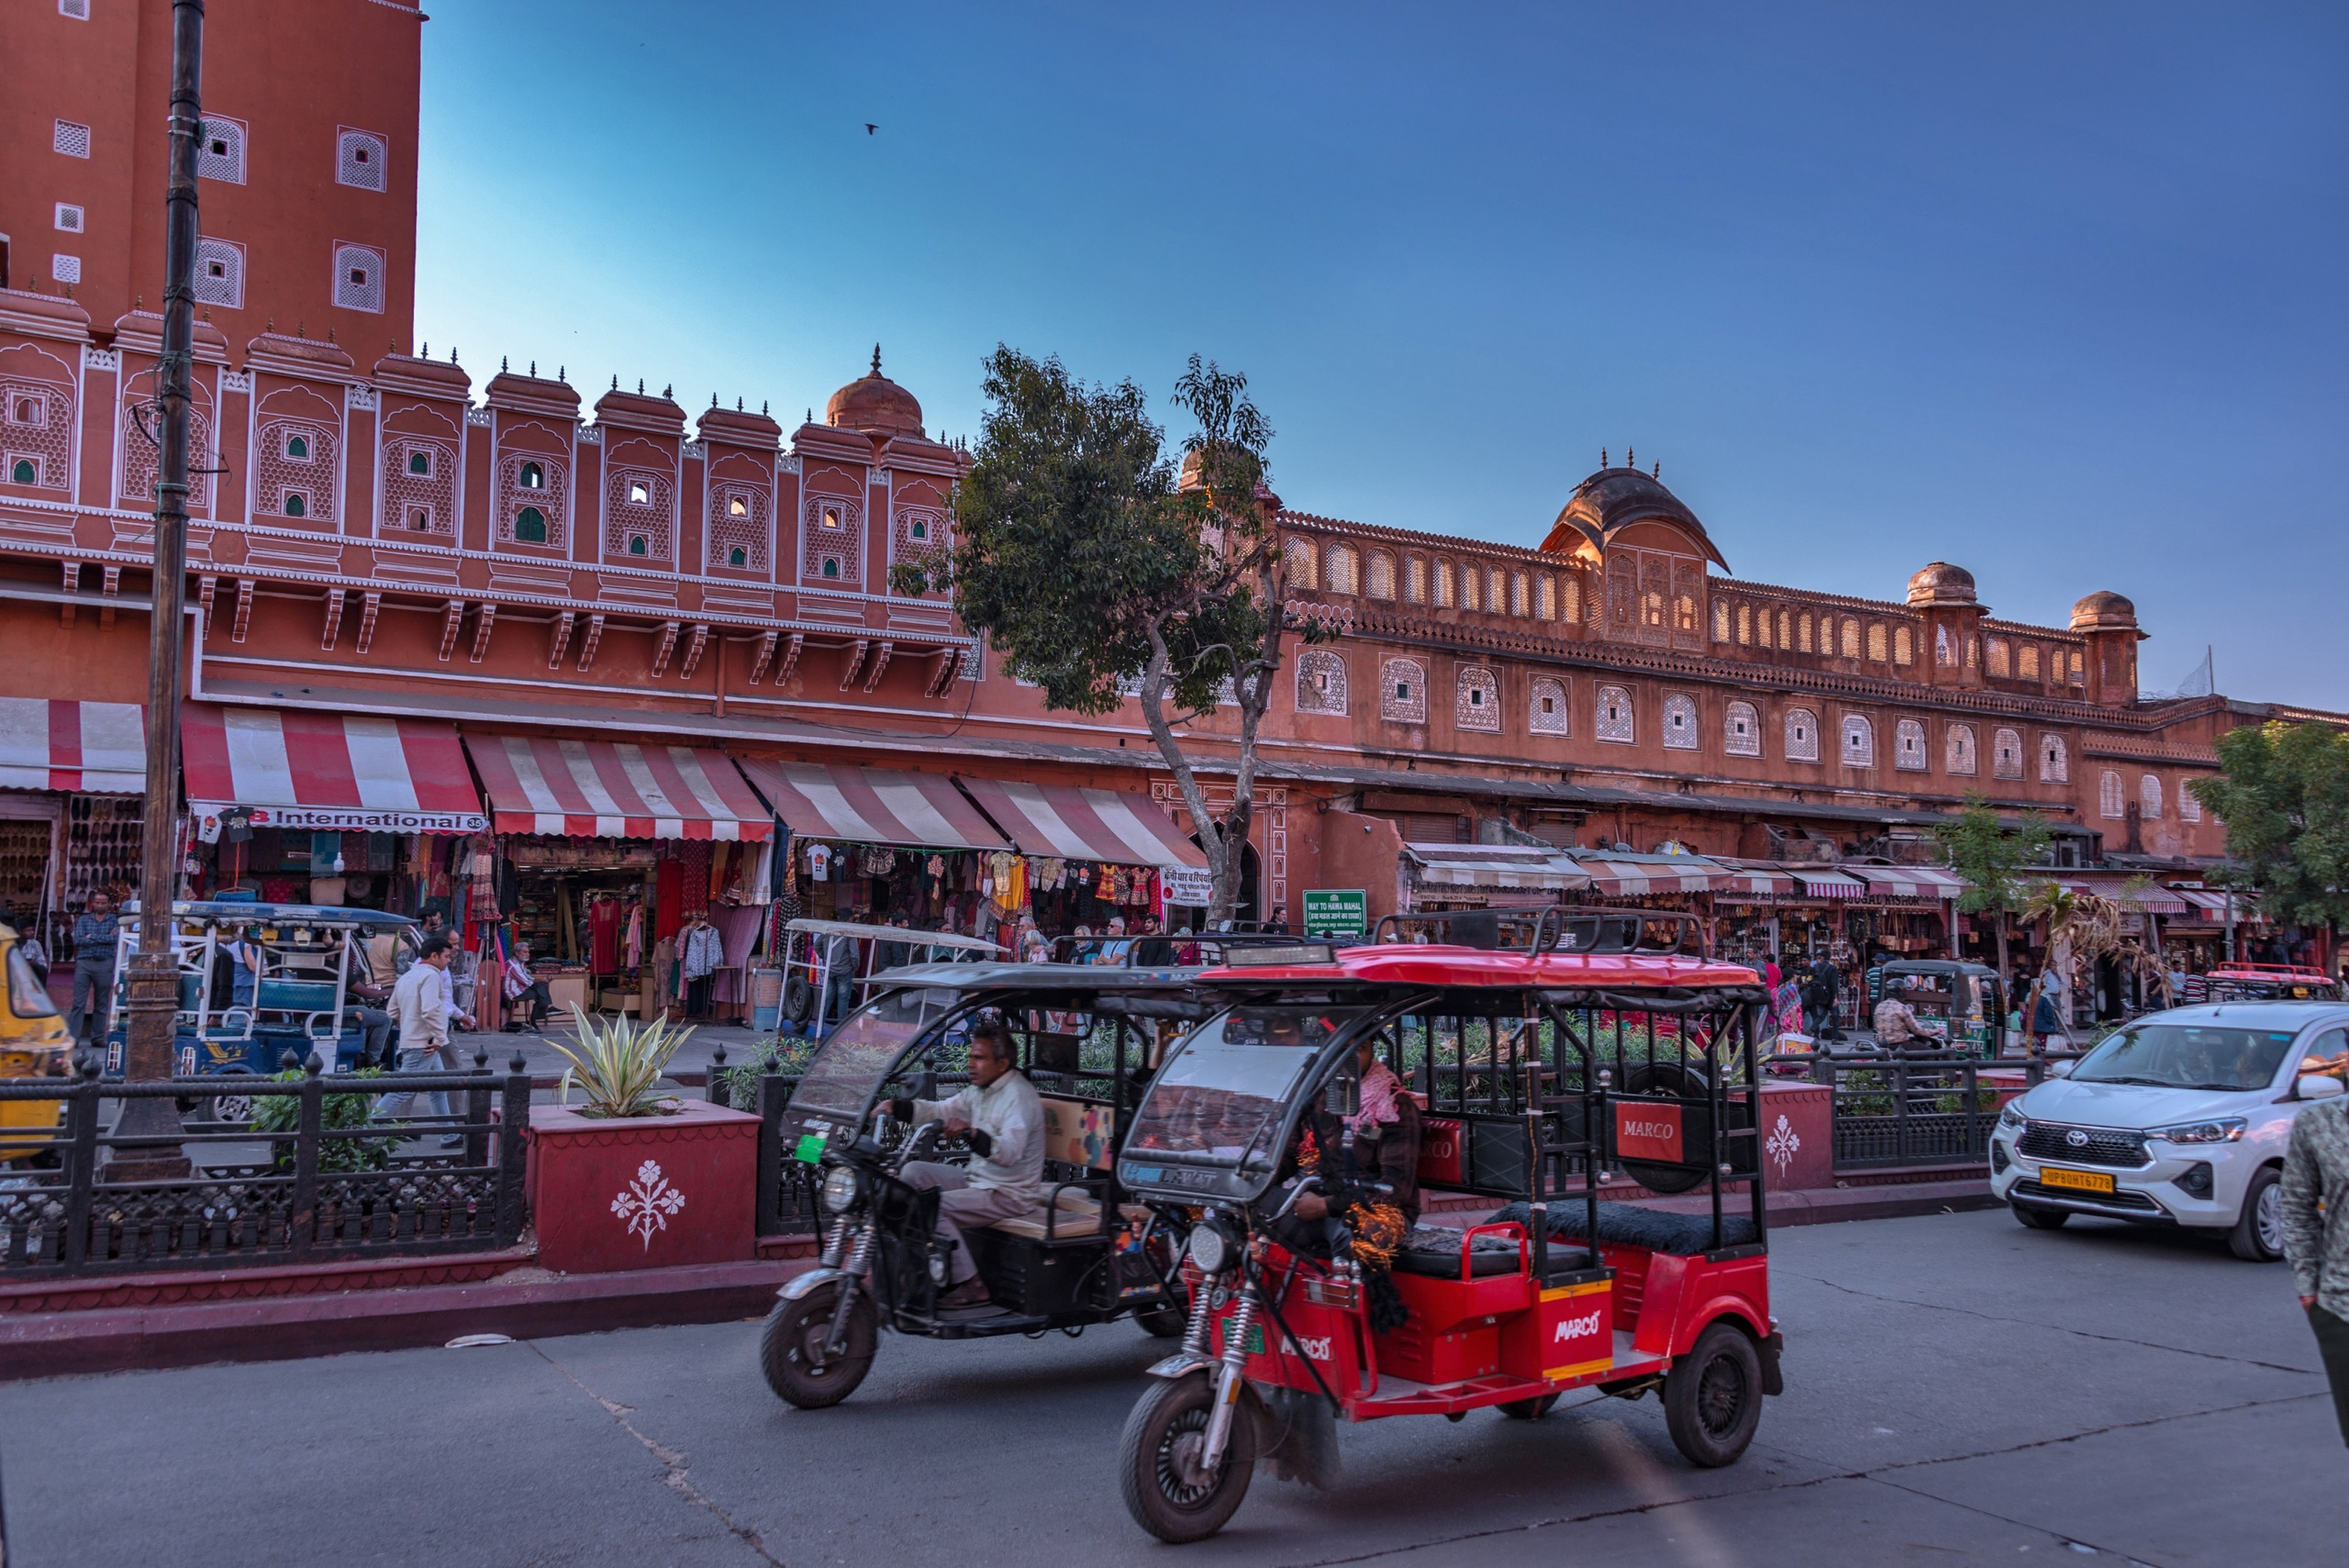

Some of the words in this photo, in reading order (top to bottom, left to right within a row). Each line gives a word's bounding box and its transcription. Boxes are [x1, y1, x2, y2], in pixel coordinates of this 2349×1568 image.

[277, 811, 461, 828] International
[468, 818, 482, 828] 35
[1308, 902, 1319, 910] WAY
[1319, 902, 1328, 910] TO
[1328, 902, 1343, 910] HAWA
[1343, 902, 1362, 910] MAHAL
[1623, 1120, 1674, 1140] MARCO
[2047, 1171, 2111, 1189] UP80HT6778
[1553, 1309, 1601, 1343] MARCO
[1280, 1335, 1331, 1361] MRCO
